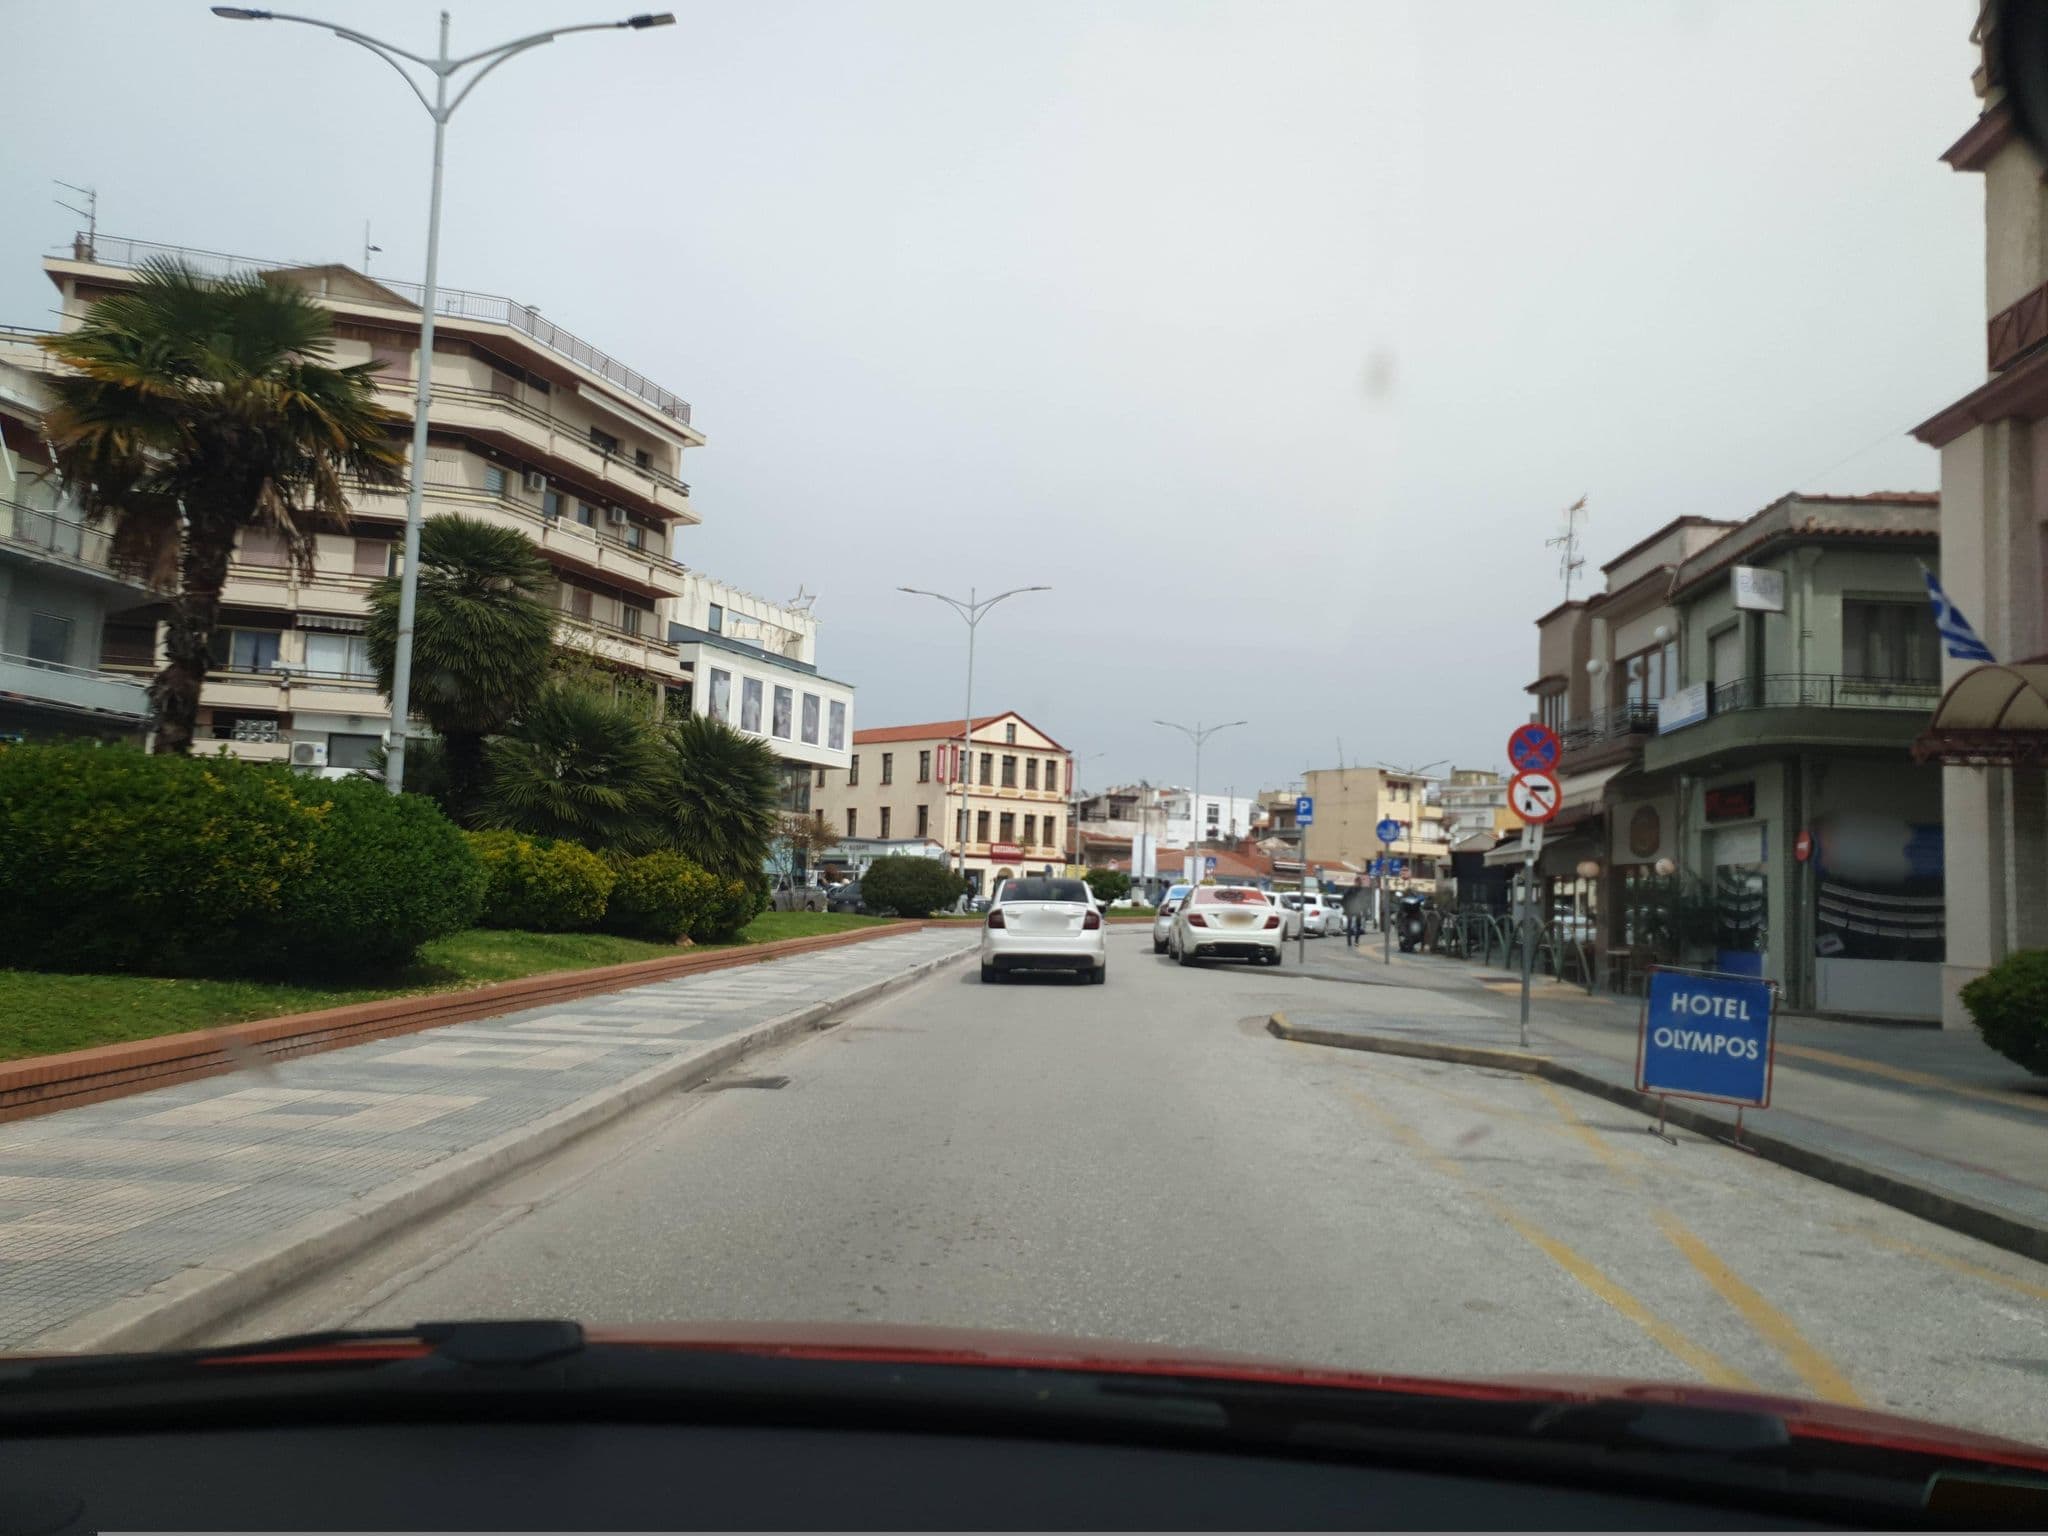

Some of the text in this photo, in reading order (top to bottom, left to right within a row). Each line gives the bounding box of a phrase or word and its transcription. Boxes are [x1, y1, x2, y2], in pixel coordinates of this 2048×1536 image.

[1299, 800, 1310, 814] P
[1672, 992, 1750, 1021] HOTEL
[1654, 1027, 1759, 1061] OLYMPOS
